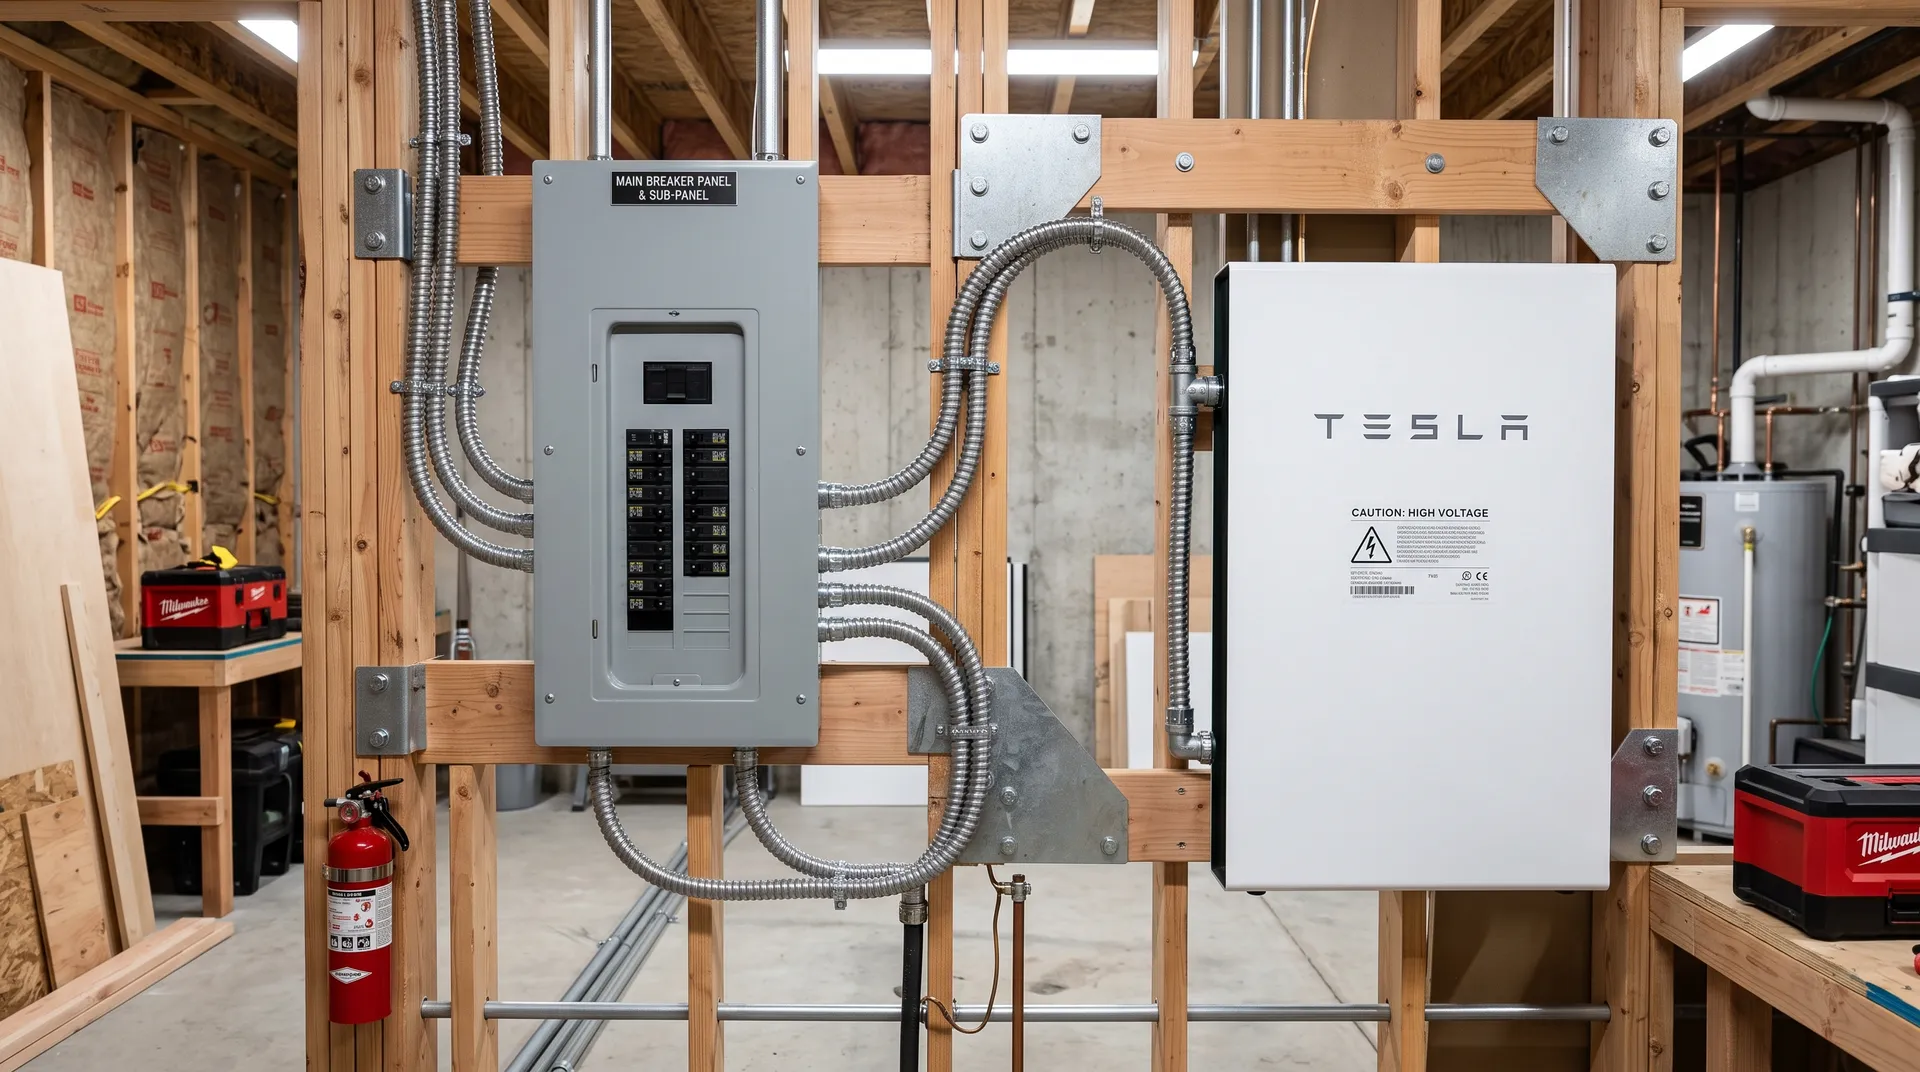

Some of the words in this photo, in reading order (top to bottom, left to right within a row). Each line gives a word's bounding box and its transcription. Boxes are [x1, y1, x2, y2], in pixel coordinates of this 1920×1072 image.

[616, 175, 643, 187] MAIN
[646, 175, 694, 187] BREAKER
[697, 175, 731, 187] PANEL
[638, 189, 646, 201] &
[649, 189, 709, 201] SUB-PANEL
[1314, 413, 1529, 441] TESLA
[1351, 508, 1406, 518] CAUTION:
[1408, 508, 1435, 518] HIGH
[1438, 508, 1489, 518] VOLTAGE
[159, 596, 209, 615] Milwaukee
[1857, 826, 1920, 858] Milwau
